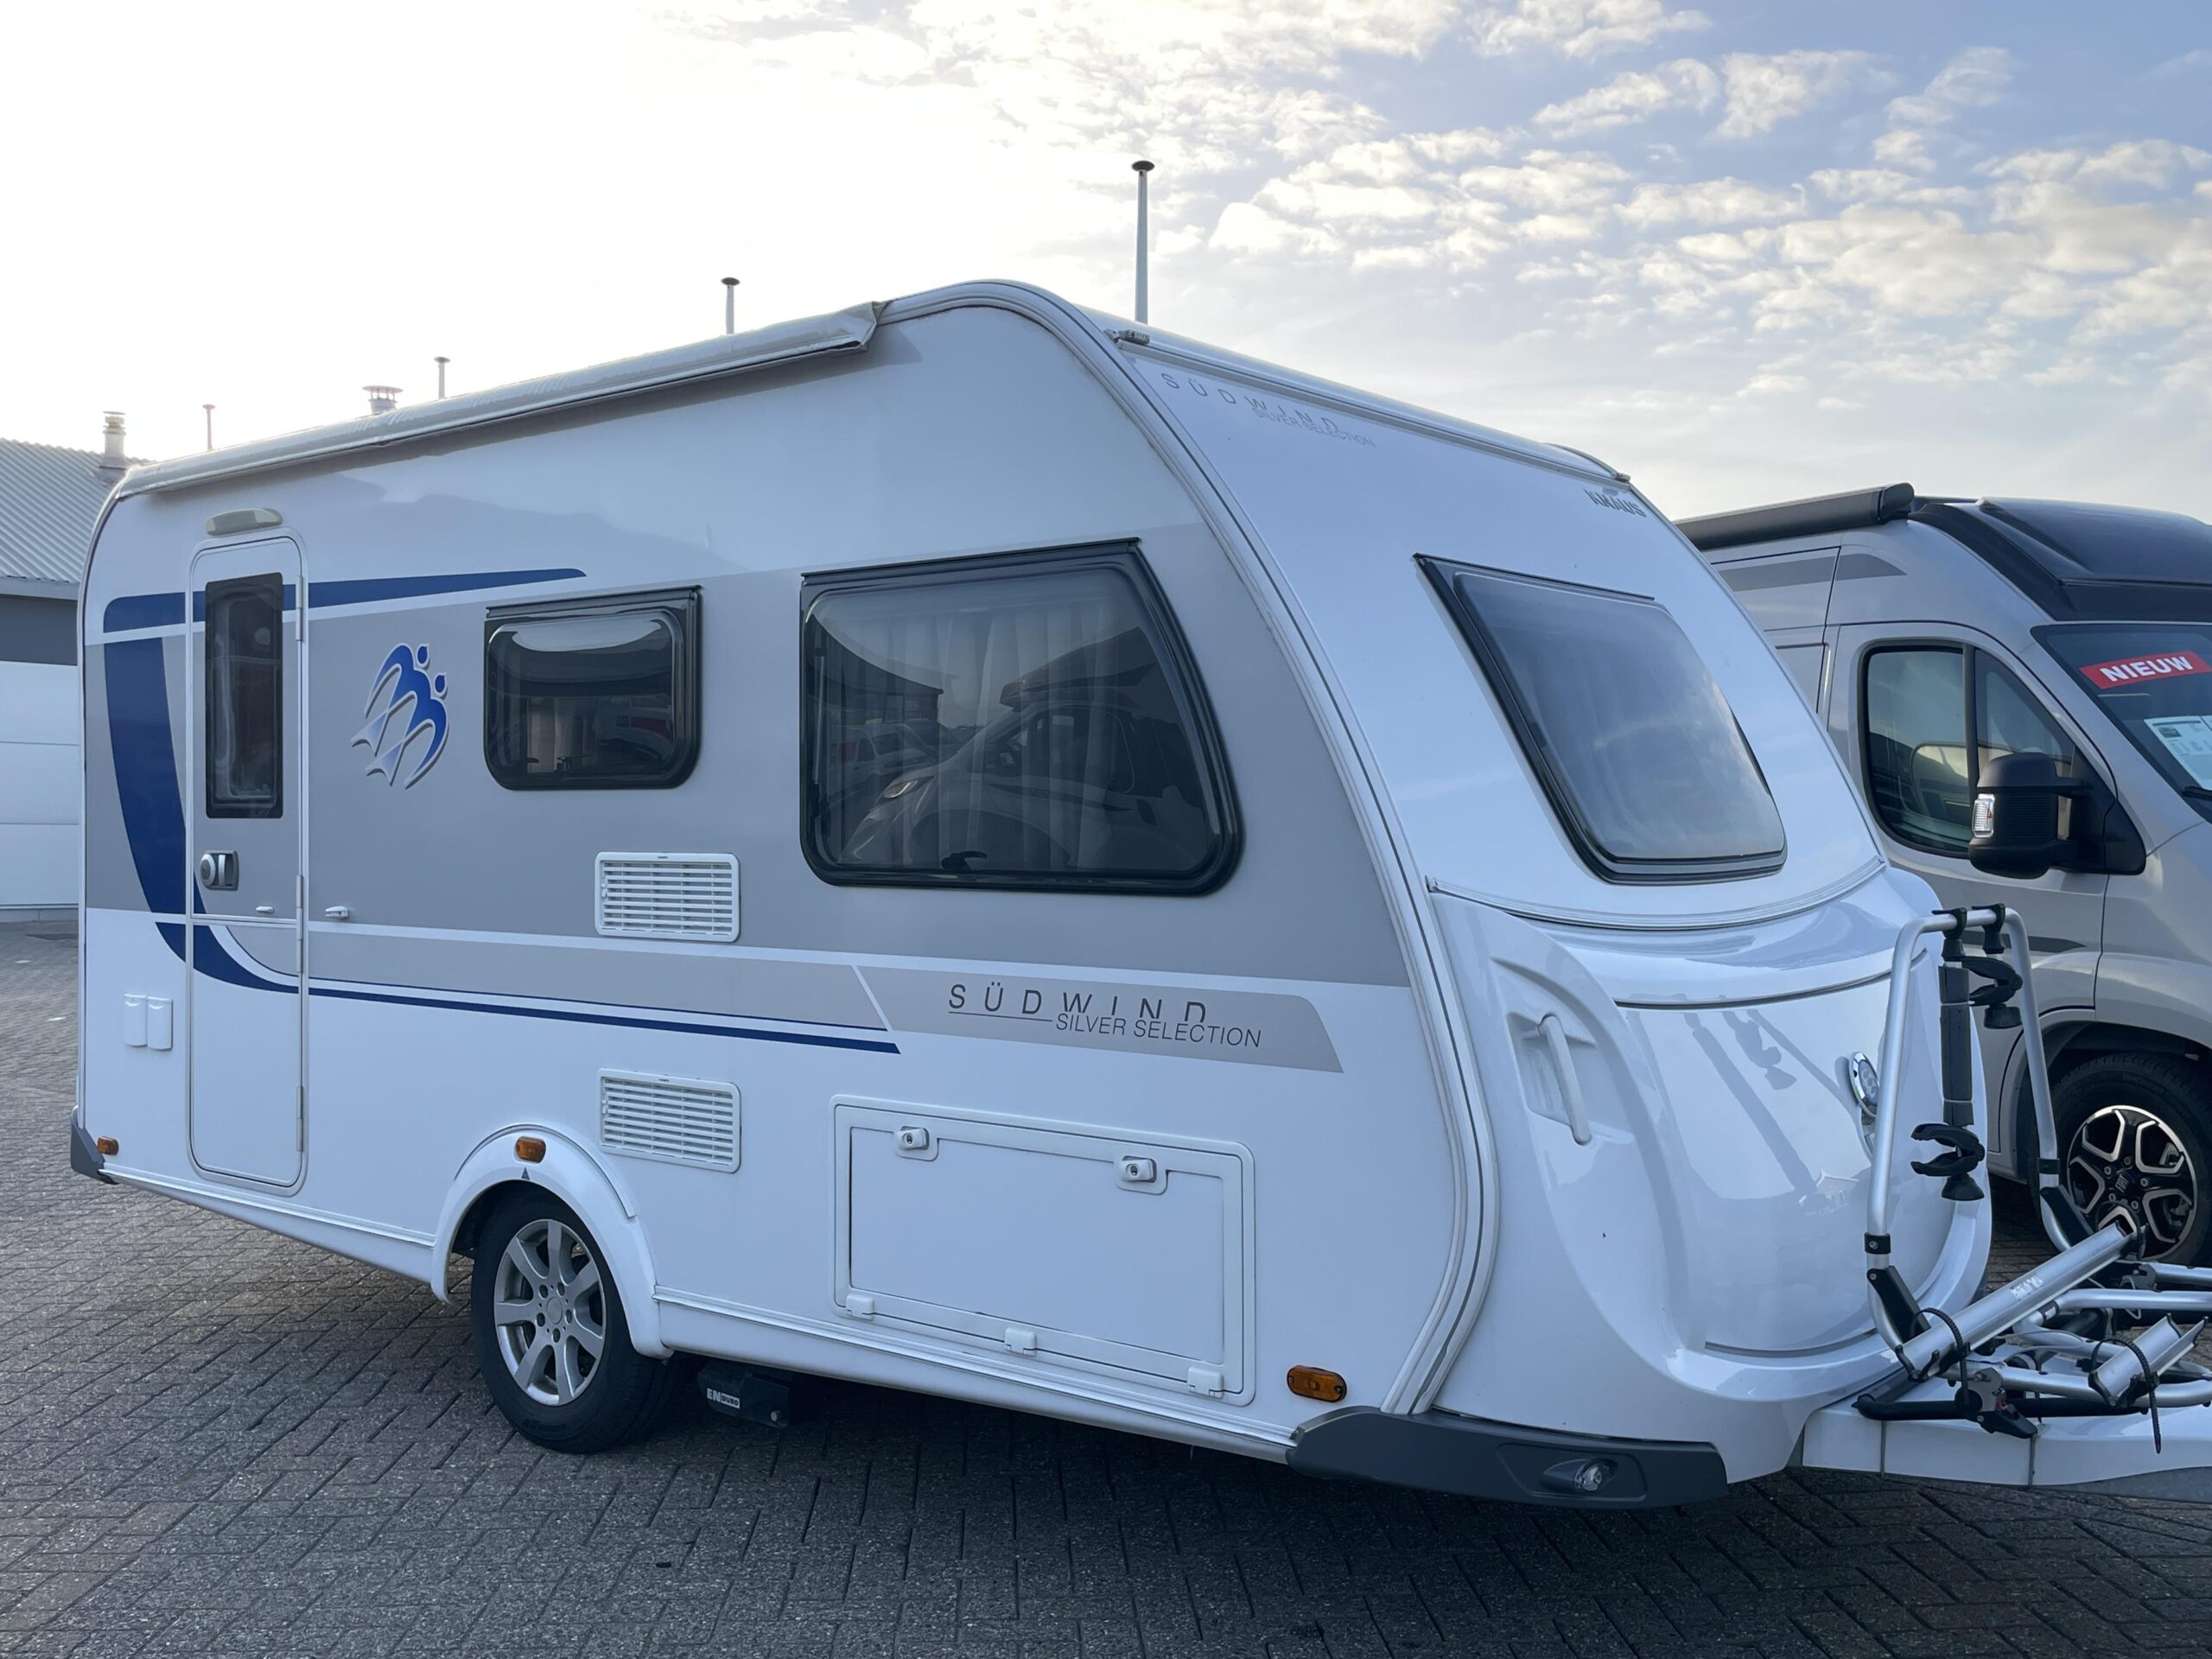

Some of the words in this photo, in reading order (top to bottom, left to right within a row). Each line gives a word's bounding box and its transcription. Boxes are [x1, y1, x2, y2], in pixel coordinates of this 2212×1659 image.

[1161, 373, 1338, 432] SÜDWIND
[1254, 409, 1300, 428] SILVER
[1302, 422, 1376, 448] SELECTION
[2100, 656, 2193, 682] NIEUW
[948, 982, 1206, 1023] SÜDWIND
[1056, 1013, 1127, 1036] SILVER
[1133, 1020, 1262, 1048] SELECTION
[707, 1387, 741, 1409] ENDURO
